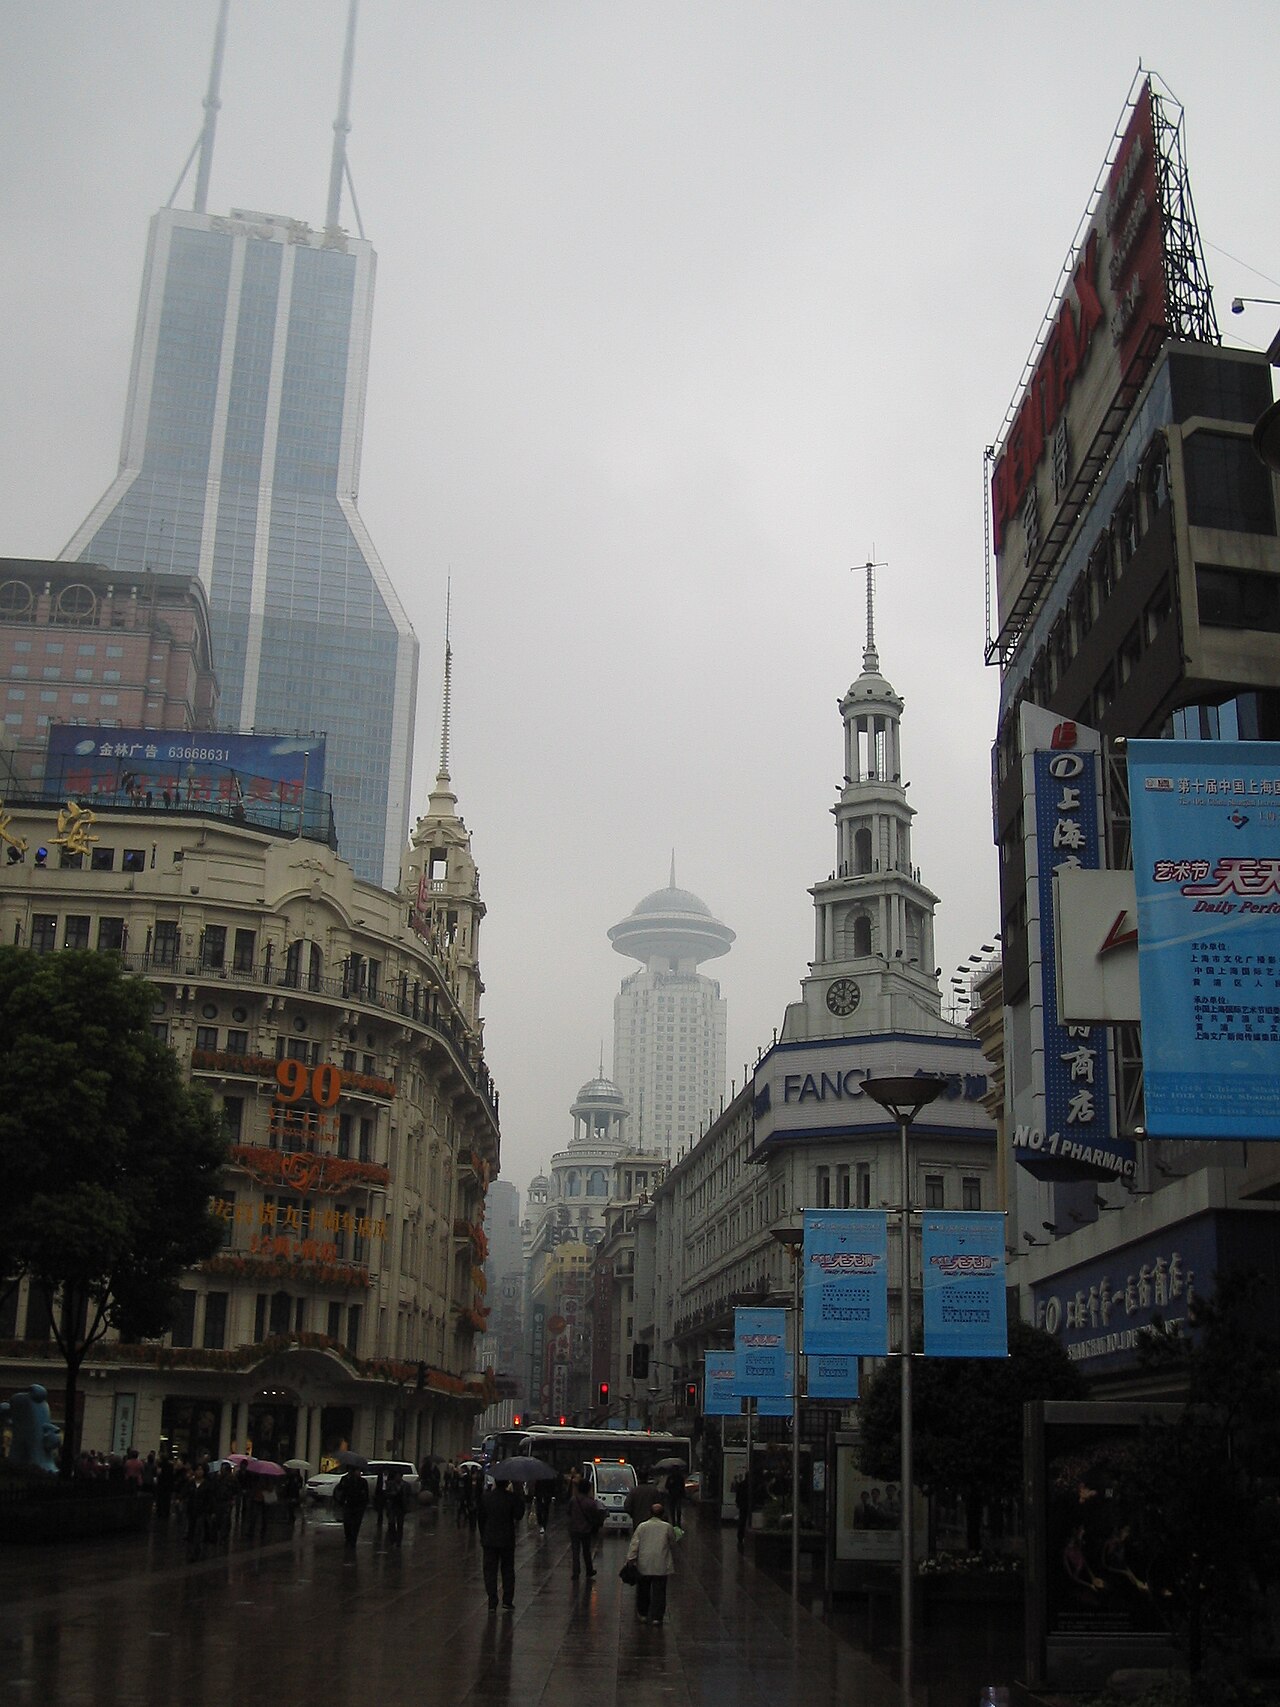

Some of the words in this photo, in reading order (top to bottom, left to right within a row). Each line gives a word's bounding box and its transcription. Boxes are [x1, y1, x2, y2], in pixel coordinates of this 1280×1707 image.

[99, 742, 158, 758] 金林广告
[168, 747, 230, 761] 63668631
[1154, 860, 1211, 881] 艺术节
[1193, 900, 1236, 915] Daily
[1194, 966, 1280, 976] 中国上海国际艺
[276, 1059, 342, 1109] 90
[784, 1068, 872, 1103] FANC
[1013, 1125, 1060, 1155] NO.1
